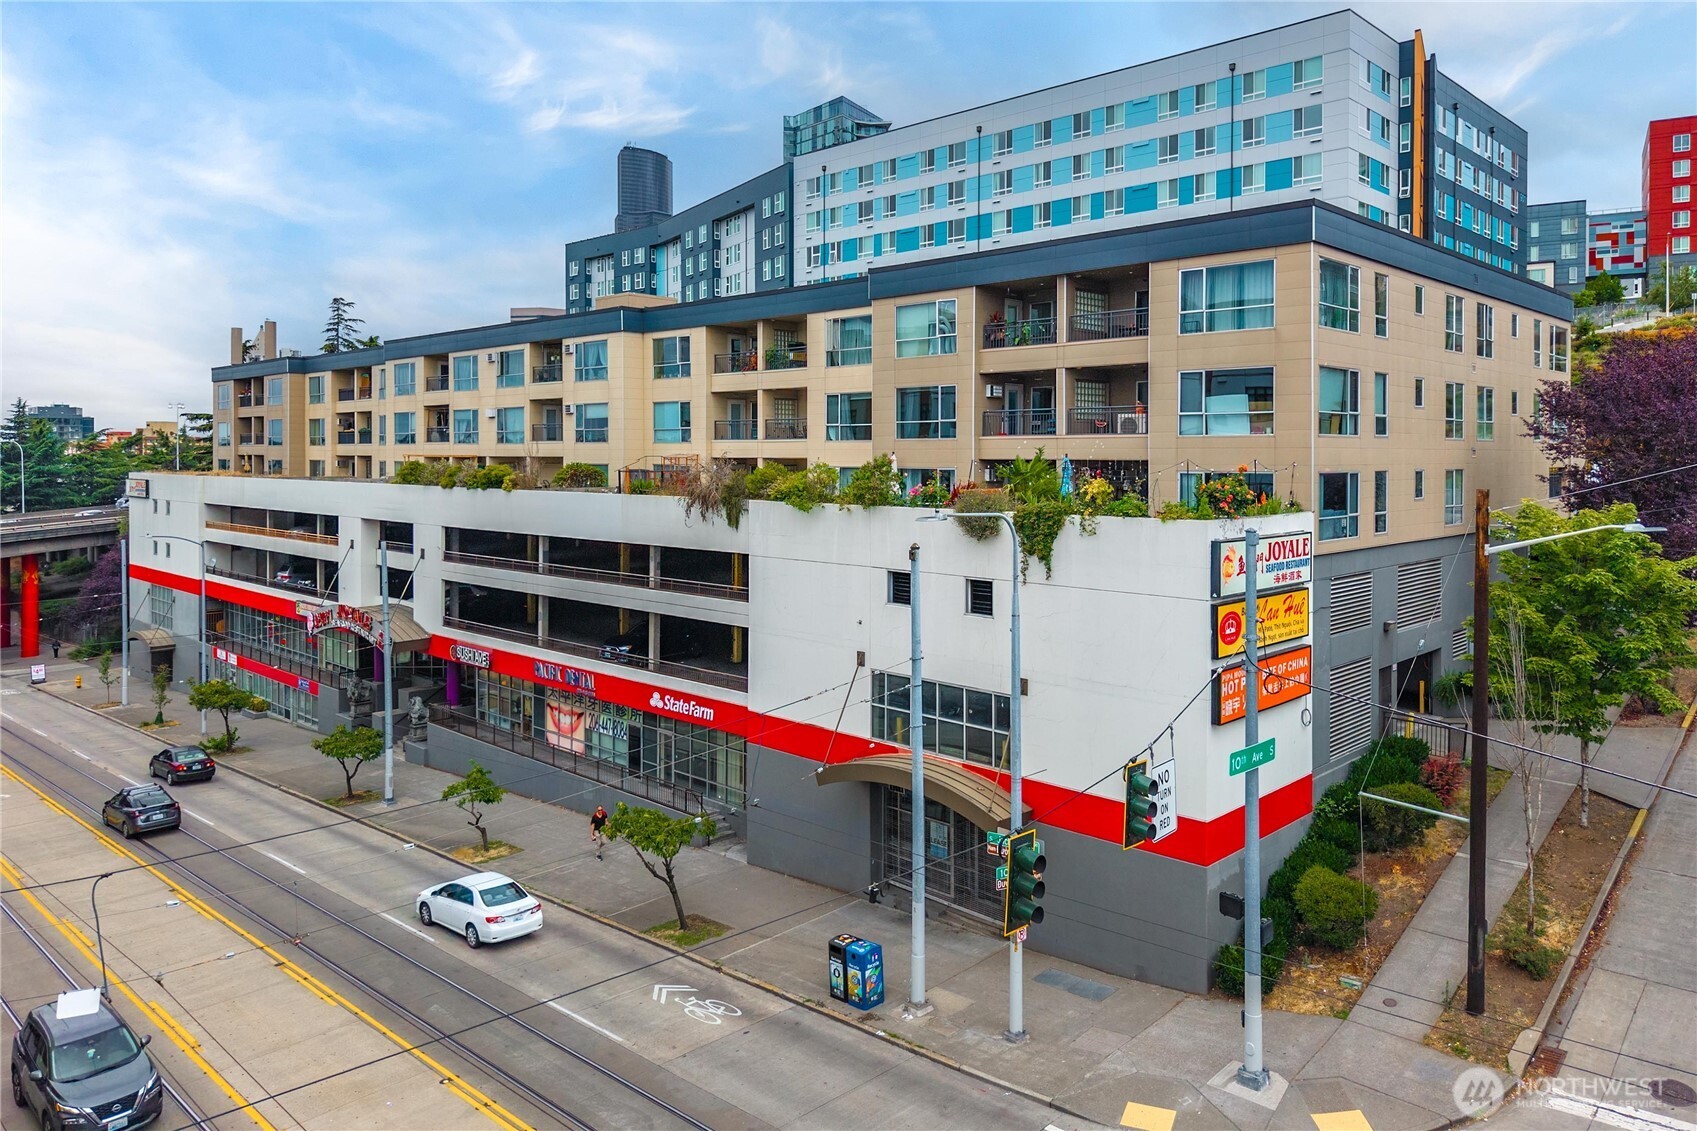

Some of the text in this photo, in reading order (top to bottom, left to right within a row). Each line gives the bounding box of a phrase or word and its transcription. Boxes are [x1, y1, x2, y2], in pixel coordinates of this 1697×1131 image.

[1265, 538, 1309, 562] JOYALE
[1266, 557, 1309, 573] SEAFOOD RESTAURANT
[1259, 599, 1279, 622] Lan
[1278, 662, 1287, 674] OF
[1288, 656, 1308, 671] CHINA
[535, 661, 596, 690] PACIFIC DENTAL
[1222, 679, 1240, 697] HOT
[1232, 744, 1274, 771] 10th Ave S
[1158, 769, 1170, 786] NO
[1157, 787, 1172, 801] TURN
[1161, 803, 1169, 815] ON
[1160, 817, 1171, 831] RED
